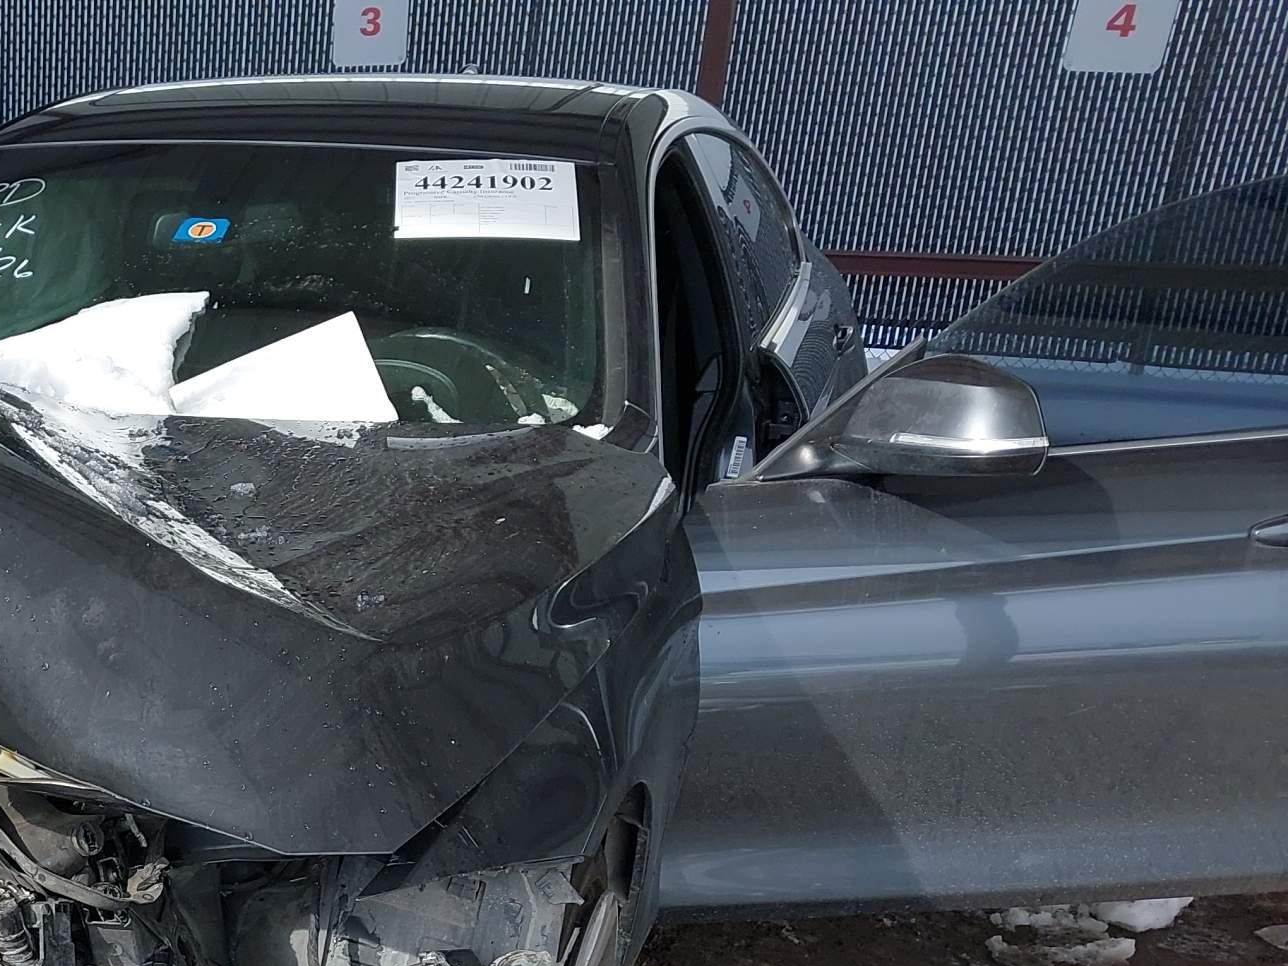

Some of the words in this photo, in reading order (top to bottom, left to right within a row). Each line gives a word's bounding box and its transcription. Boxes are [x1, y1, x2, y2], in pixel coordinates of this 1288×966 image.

[359, 7, 381, 37] 3
[1105, 4, 1137, 37] 4
[414, 174, 553, 191] 44241902
